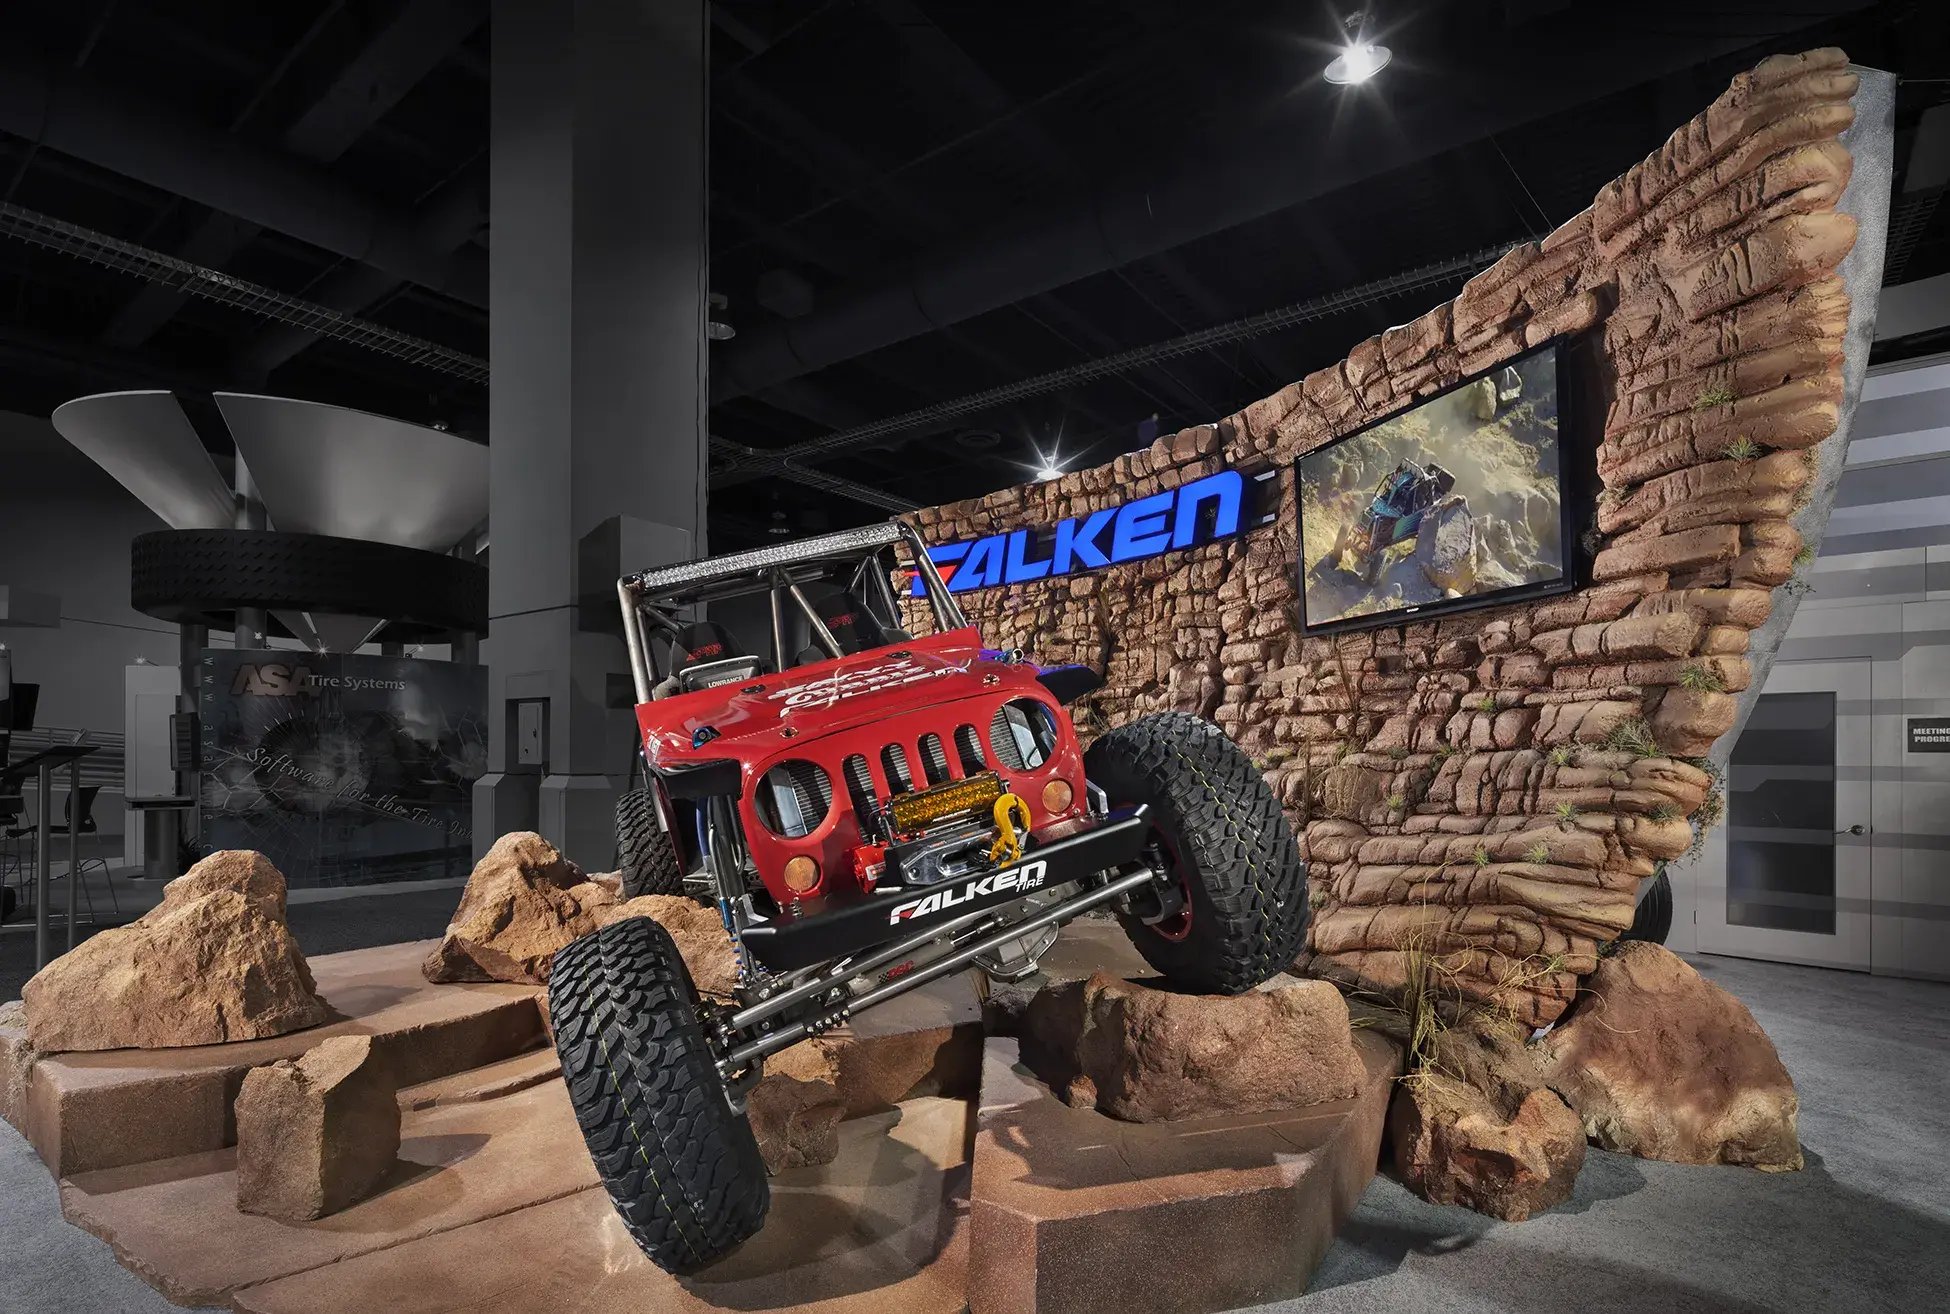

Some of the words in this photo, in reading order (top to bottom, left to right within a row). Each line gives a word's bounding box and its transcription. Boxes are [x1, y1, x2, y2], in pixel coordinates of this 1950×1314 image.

[911, 469, 1244, 597] FALKEN
[229, 664, 324, 697] ASA
[309, 674, 340, 688] Tire
[344, 676, 406, 691] Systems
[708, 675, 744, 689] LOWRANCE
[246, 747, 335, 791] Software
[336, 780, 370, 802] for
[375, 794, 403, 816] the
[410, 806, 444, 829] Tire
[889, 860, 1048, 926] FALKEN
[1015, 876, 1045, 893] TIRE
